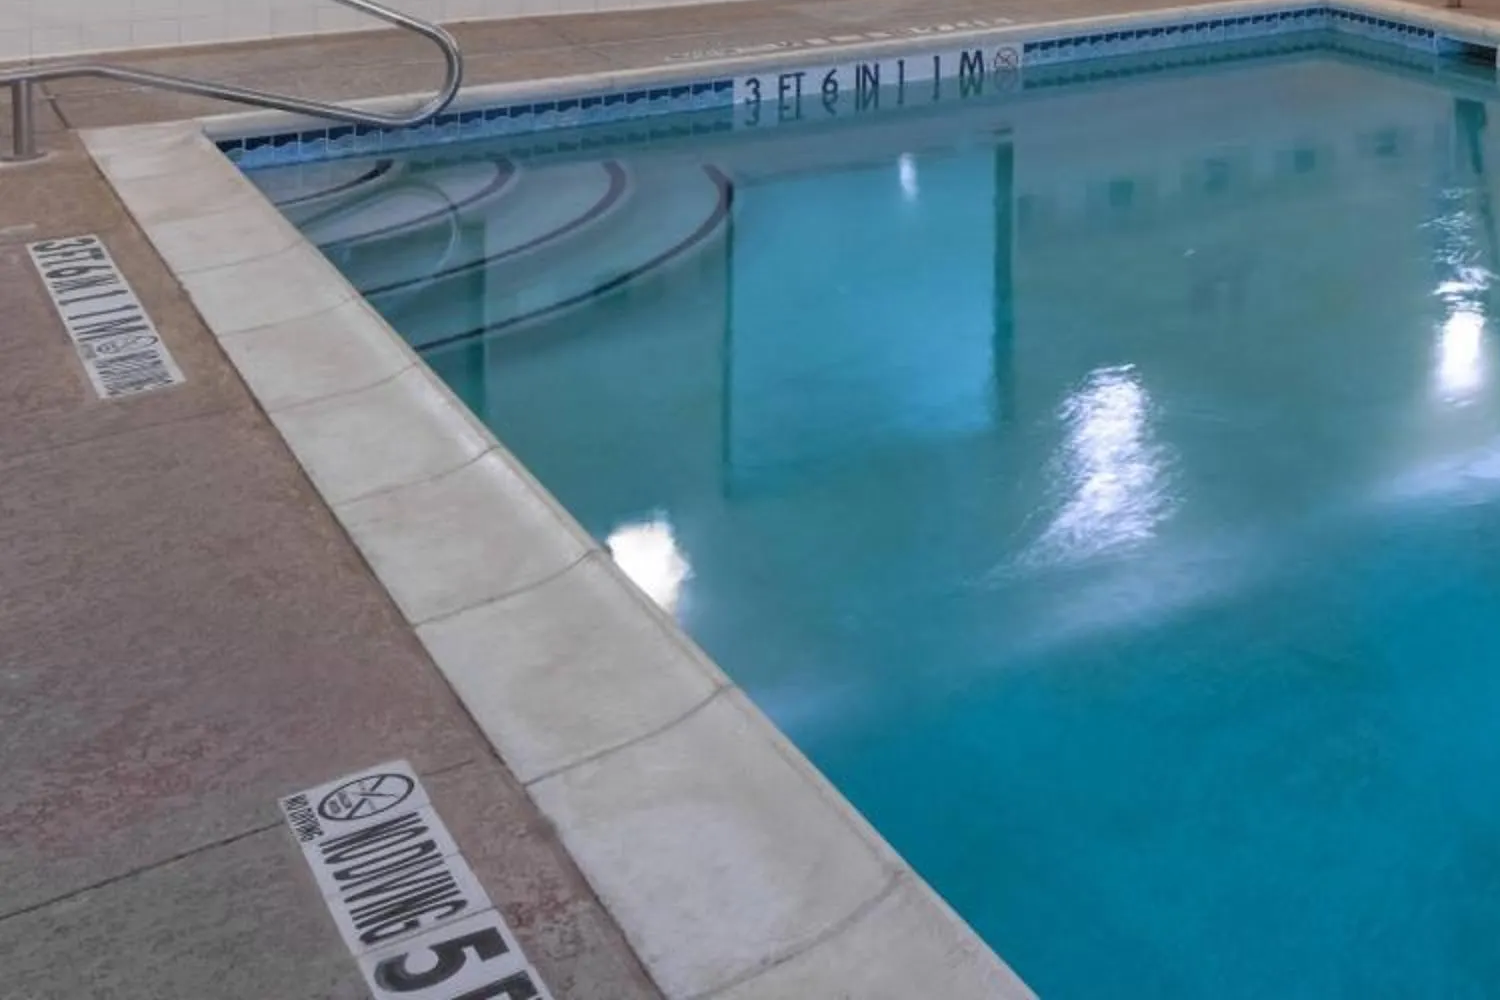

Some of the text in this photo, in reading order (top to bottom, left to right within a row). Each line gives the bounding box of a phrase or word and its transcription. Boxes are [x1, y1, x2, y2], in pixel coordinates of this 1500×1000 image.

[745, 77, 760, 105] 3
[778, 72, 805, 99] FT
[821, 68, 838, 95] 6
[855, 63, 880, 90] IN
[959, 49, 985, 75] M
[318, 811, 430, 865] NO
[332, 839, 469, 946] DIVING
[374, 926, 510, 993] 5
